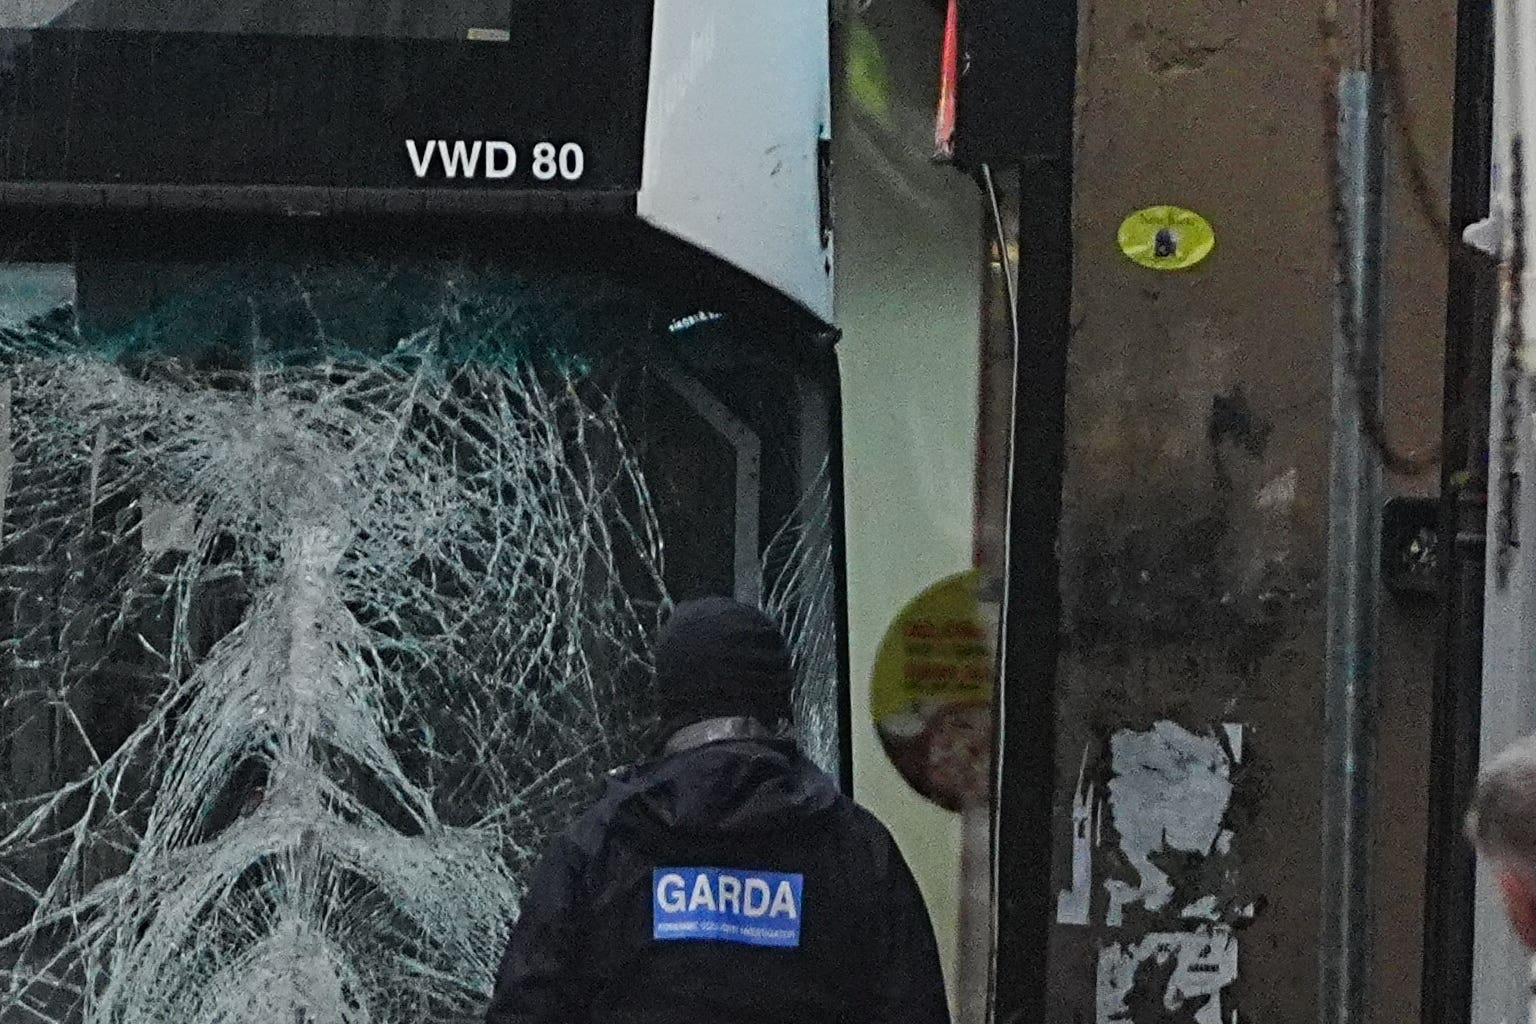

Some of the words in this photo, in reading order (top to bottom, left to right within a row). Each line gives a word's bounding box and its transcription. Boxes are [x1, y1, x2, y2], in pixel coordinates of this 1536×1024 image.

[405, 139, 517, 178] VWD
[531, 141, 584, 180] 80
[657, 873, 797, 919] GARDA
